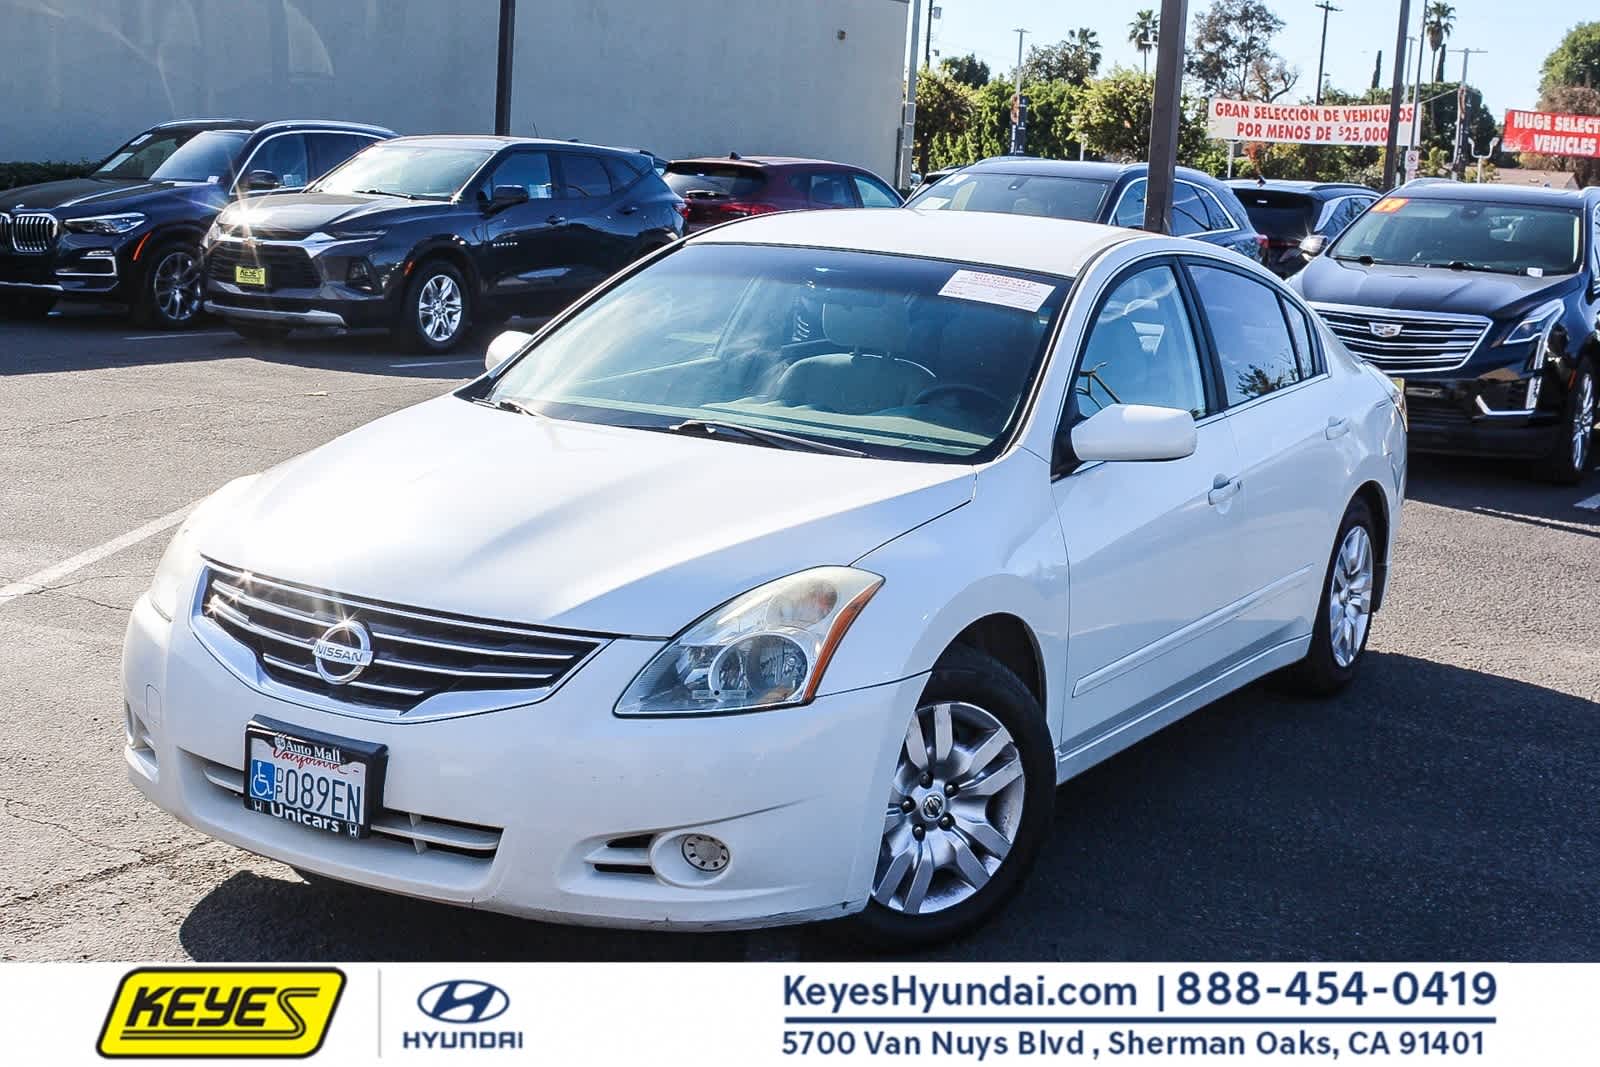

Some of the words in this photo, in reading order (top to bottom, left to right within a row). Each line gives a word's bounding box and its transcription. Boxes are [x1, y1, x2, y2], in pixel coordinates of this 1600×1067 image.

[1215, 102, 1249, 118] GRAN
[1324, 109, 1339, 122] DE
[1343, 107, 1413, 123] VEHICUOS
[1513, 111, 1552, 130] HUGE
[1554, 115, 1600, 134] SELECT
[1236, 122, 1262, 137] POR
[1266, 124, 1310, 139] MENOS
[1316, 126, 1331, 141] DE
[1338, 125, 1388, 142] $25,000
[1534, 134, 1597, 155] VEHICLES
[315, 644, 363, 662] NISSAN
[286, 740, 312, 756] Auto
[314, 747, 341, 763] Mall
[285, 769, 361, 824] 089EN
[270, 802, 340, 833] Unicars
